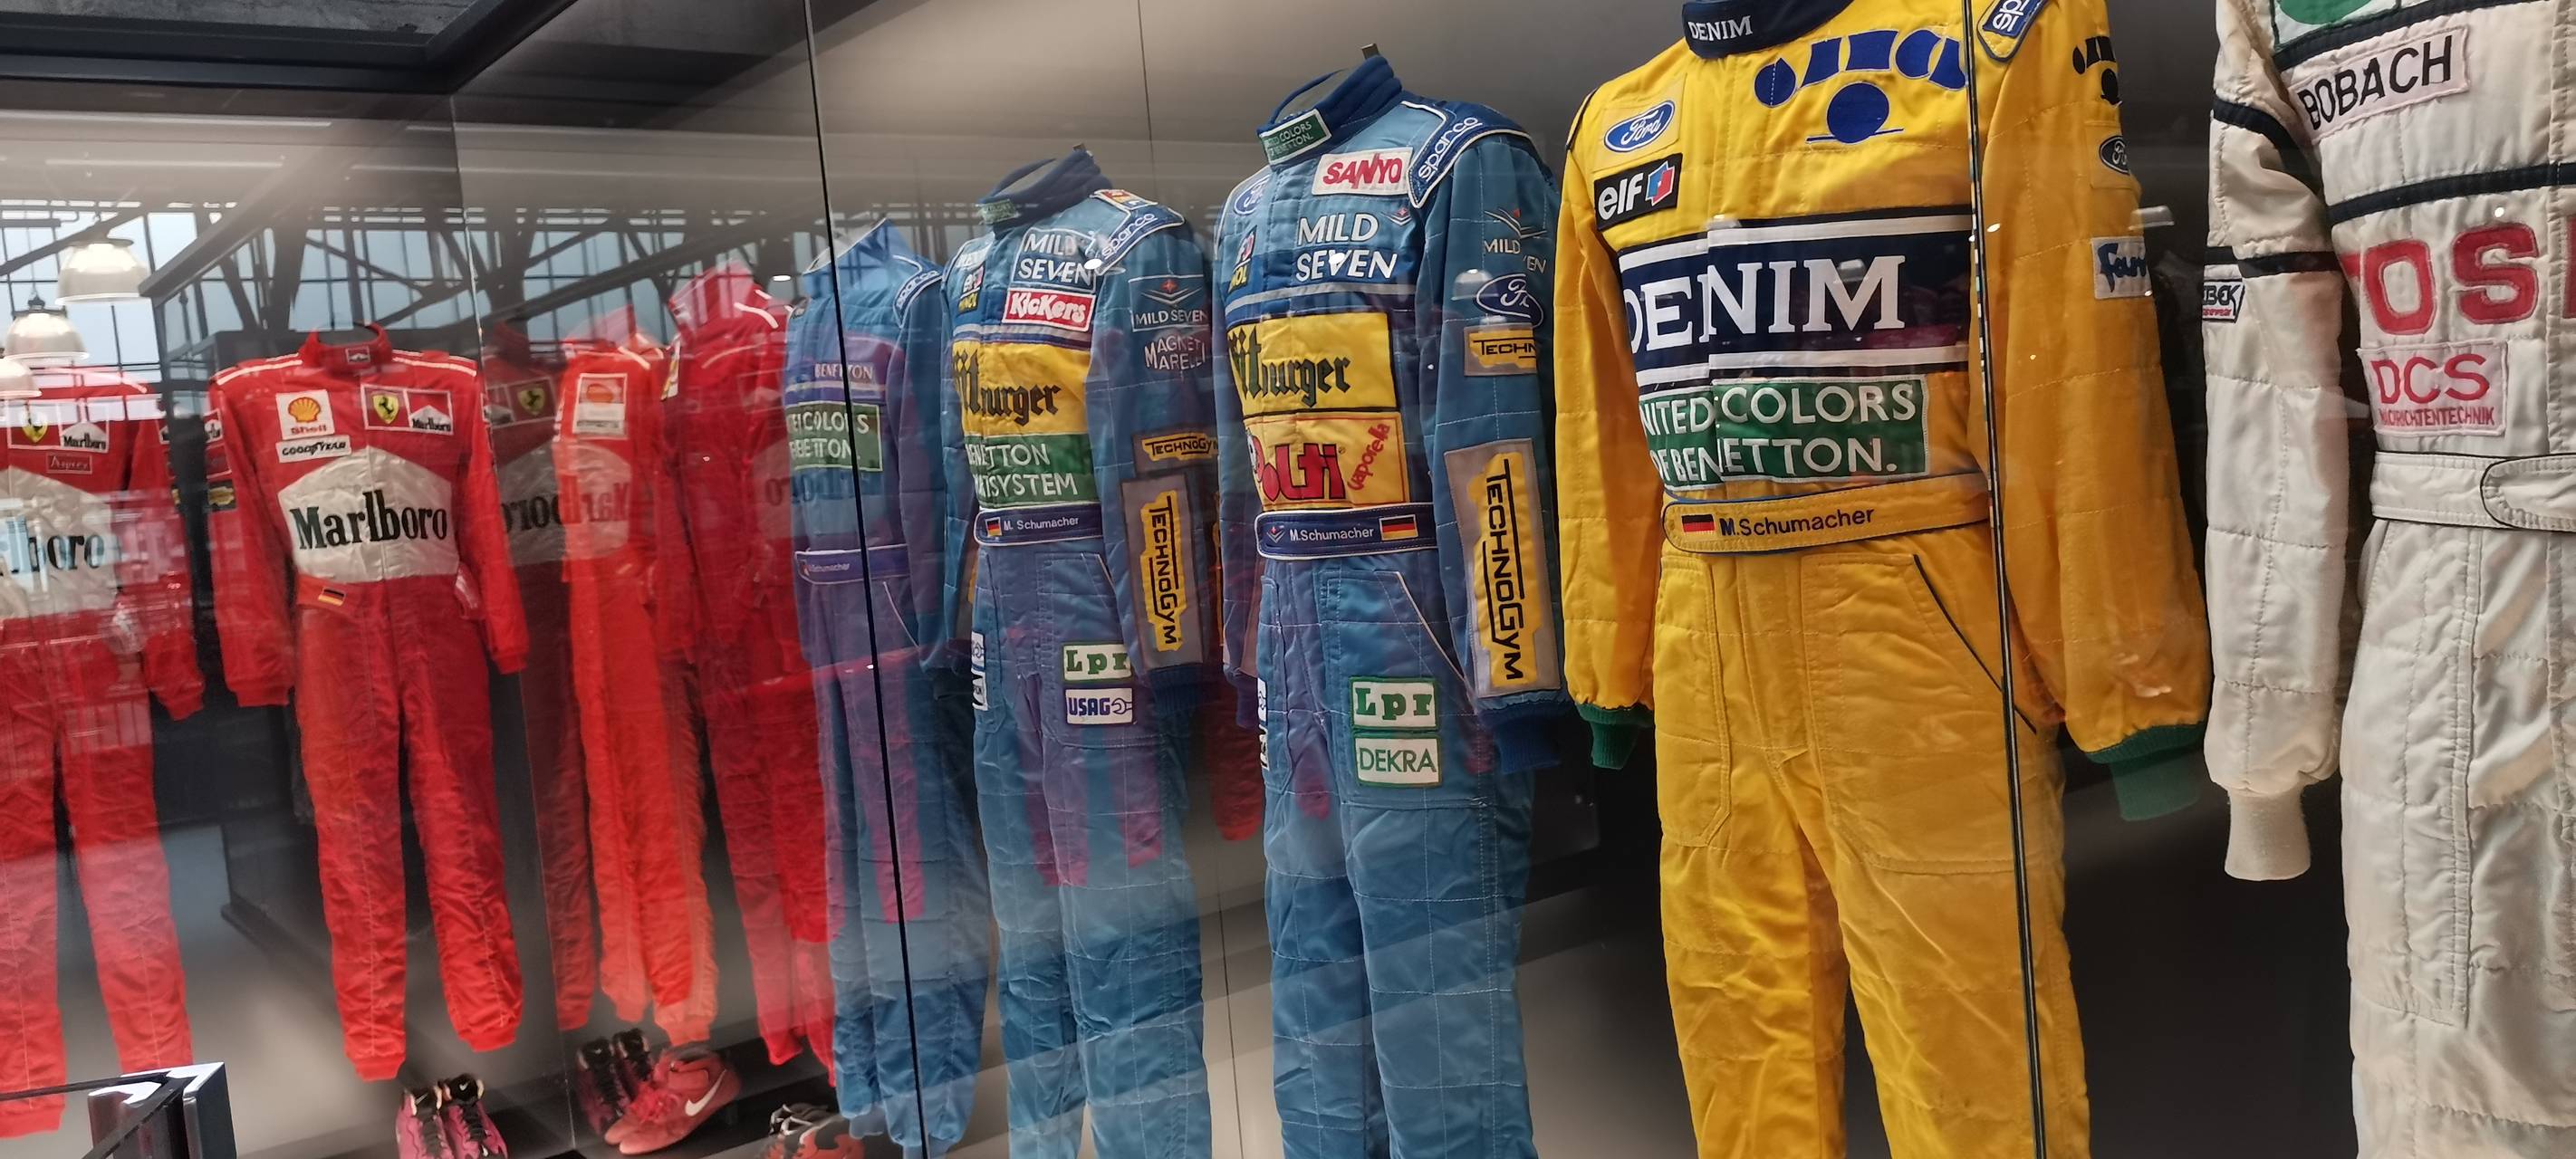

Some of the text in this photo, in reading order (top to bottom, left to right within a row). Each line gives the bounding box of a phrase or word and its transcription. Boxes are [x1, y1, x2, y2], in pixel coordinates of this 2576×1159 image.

[1688, 15, 1754, 42] DENIM
[2297, 35, 2453, 130] BOBACH
[1280, 120, 1312, 142] COLORS
[1620, 110, 1663, 145] Ford
[1418, 116, 1483, 182] sparco
[1322, 153, 1403, 189] SANYO
[1597, 172, 1644, 221] elf
[1024, 233, 1078, 256] MILD
[1101, 213, 1158, 260] sparco
[1297, 213, 1379, 246] MILD
[1483, 238, 1522, 254] MILD
[1295, 249, 1398, 283] SEVEN
[1135, 309, 1208, 326] MILD SEVEN
[1623, 254, 1906, 354] DENIM
[2369, 353, 2491, 405] DCS
[1639, 382, 1917, 439] NITED COLORS
[282, 440, 346, 456] GOODYEAR
[289, 489, 447, 550] Marlboro
[1016, 516, 1080, 531] Schumacher
[1148, 494, 1181, 645] TECHNOGYM
[1485, 458, 1525, 681] TECHNOGYM
[1068, 696, 1110, 716] USAG
[1354, 686, 1433, 721] Lpr
[1360, 749, 1437, 773] DEKRA
